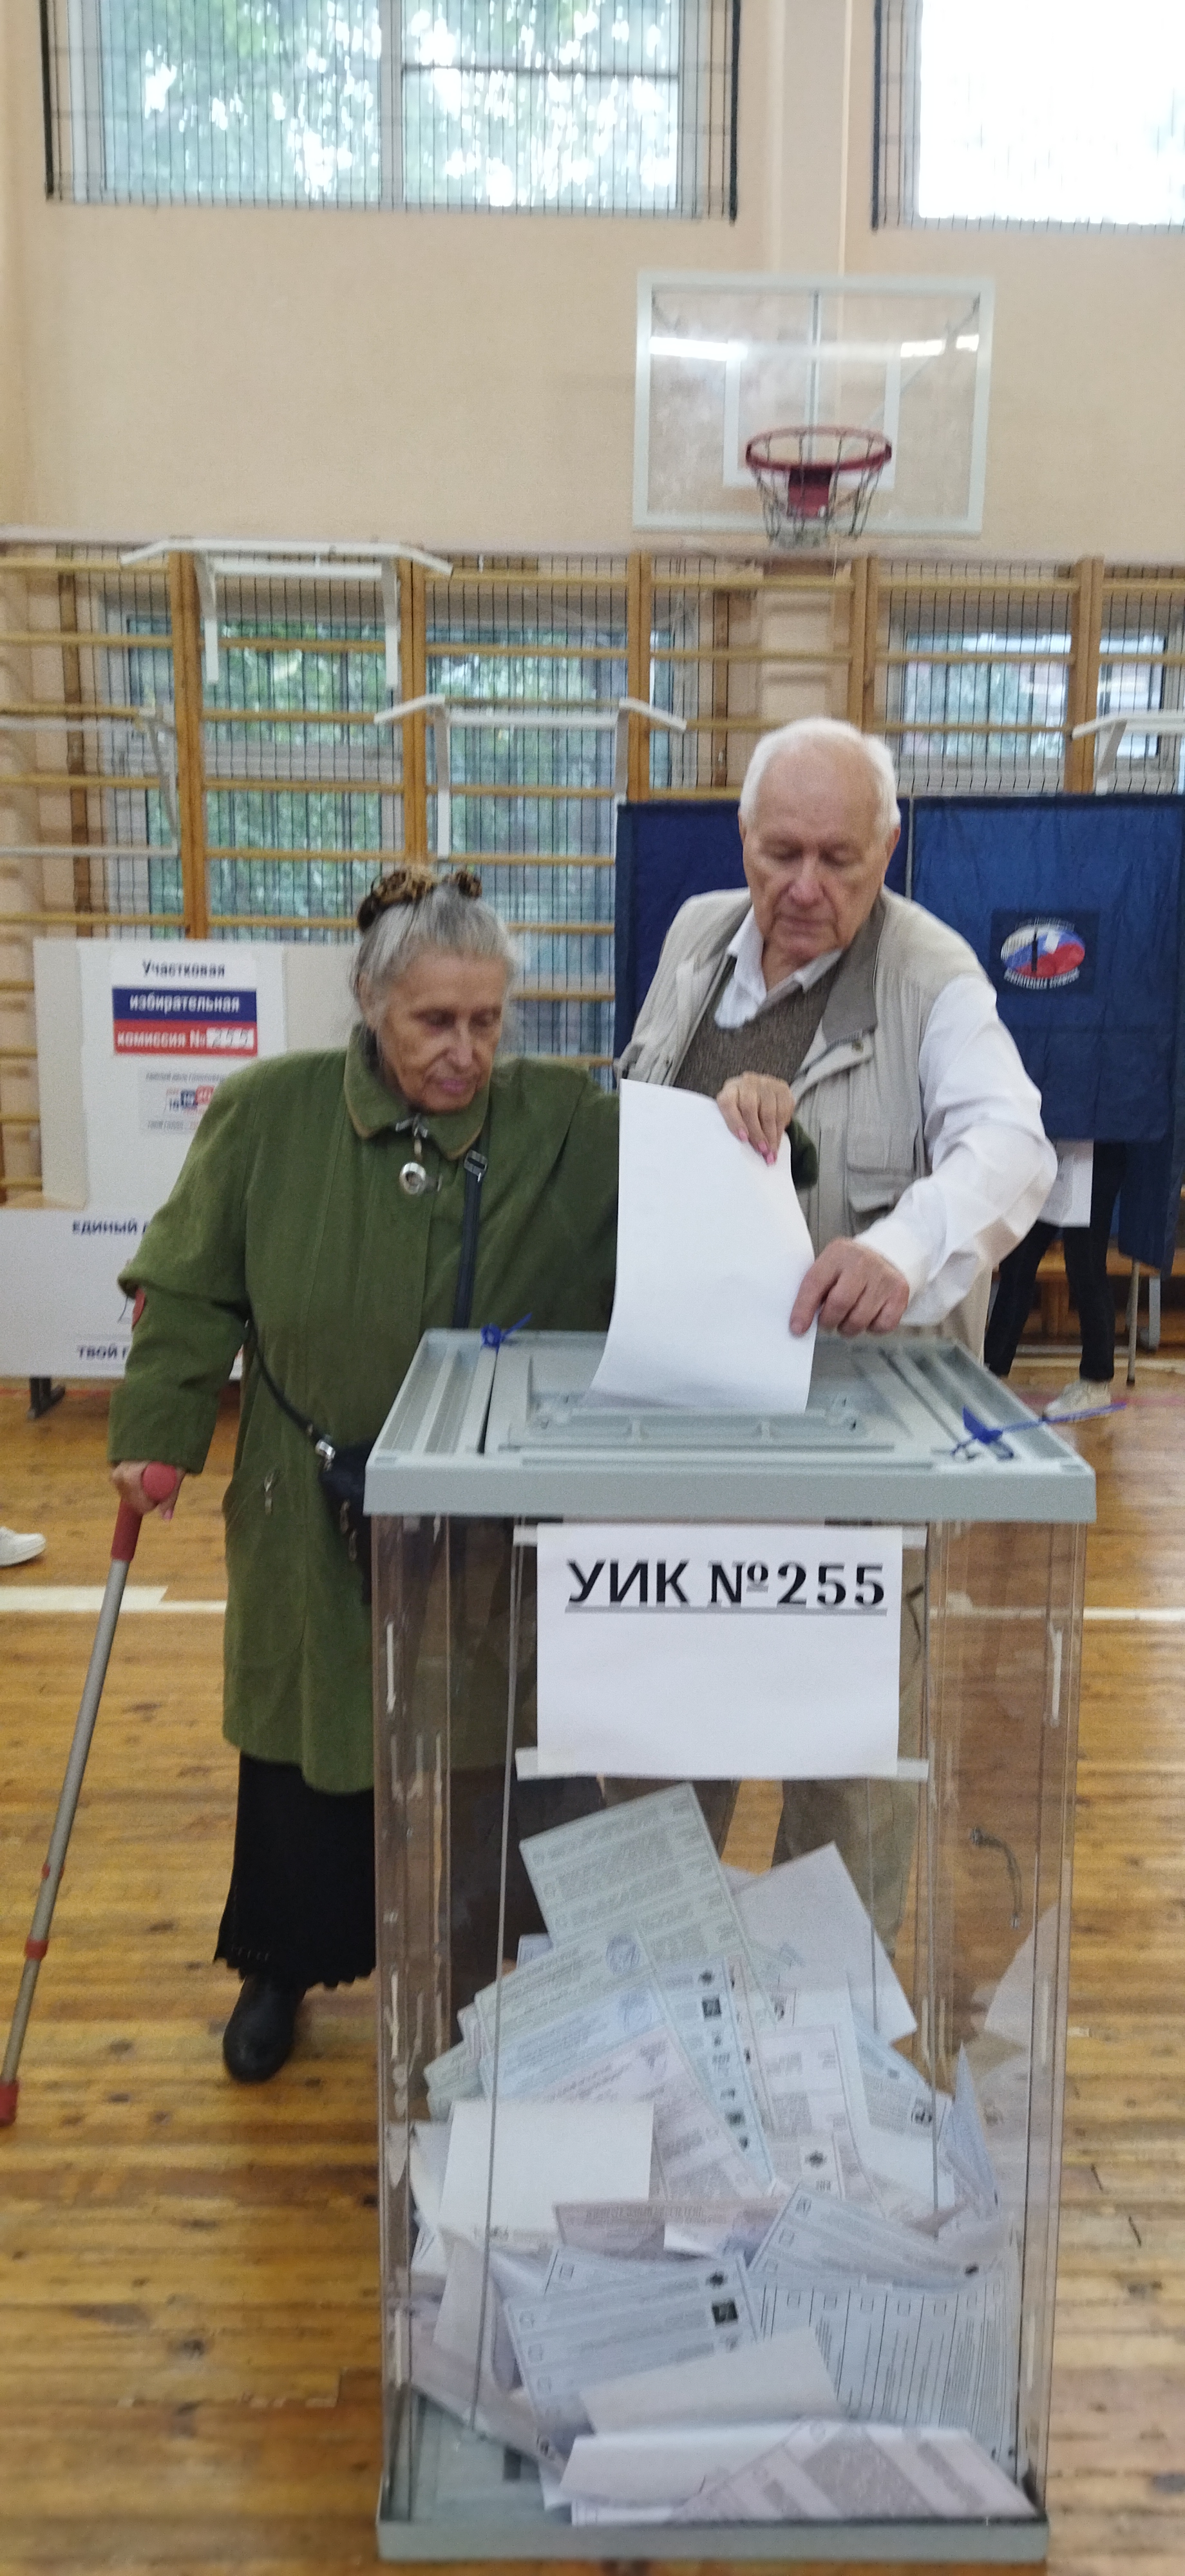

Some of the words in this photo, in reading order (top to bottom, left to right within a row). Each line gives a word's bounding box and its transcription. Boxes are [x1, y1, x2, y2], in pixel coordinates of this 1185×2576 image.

[142, 960, 225, 978] Участковая
[130, 992, 240, 1014] избирательная
[117, 1032, 186, 1048] комиссия
[72, 1217, 137, 1235] ЕДИНЫЙ
[77, 1343, 117, 1359] ТВОЙ
[566, 1559, 690, 1607] УИК
